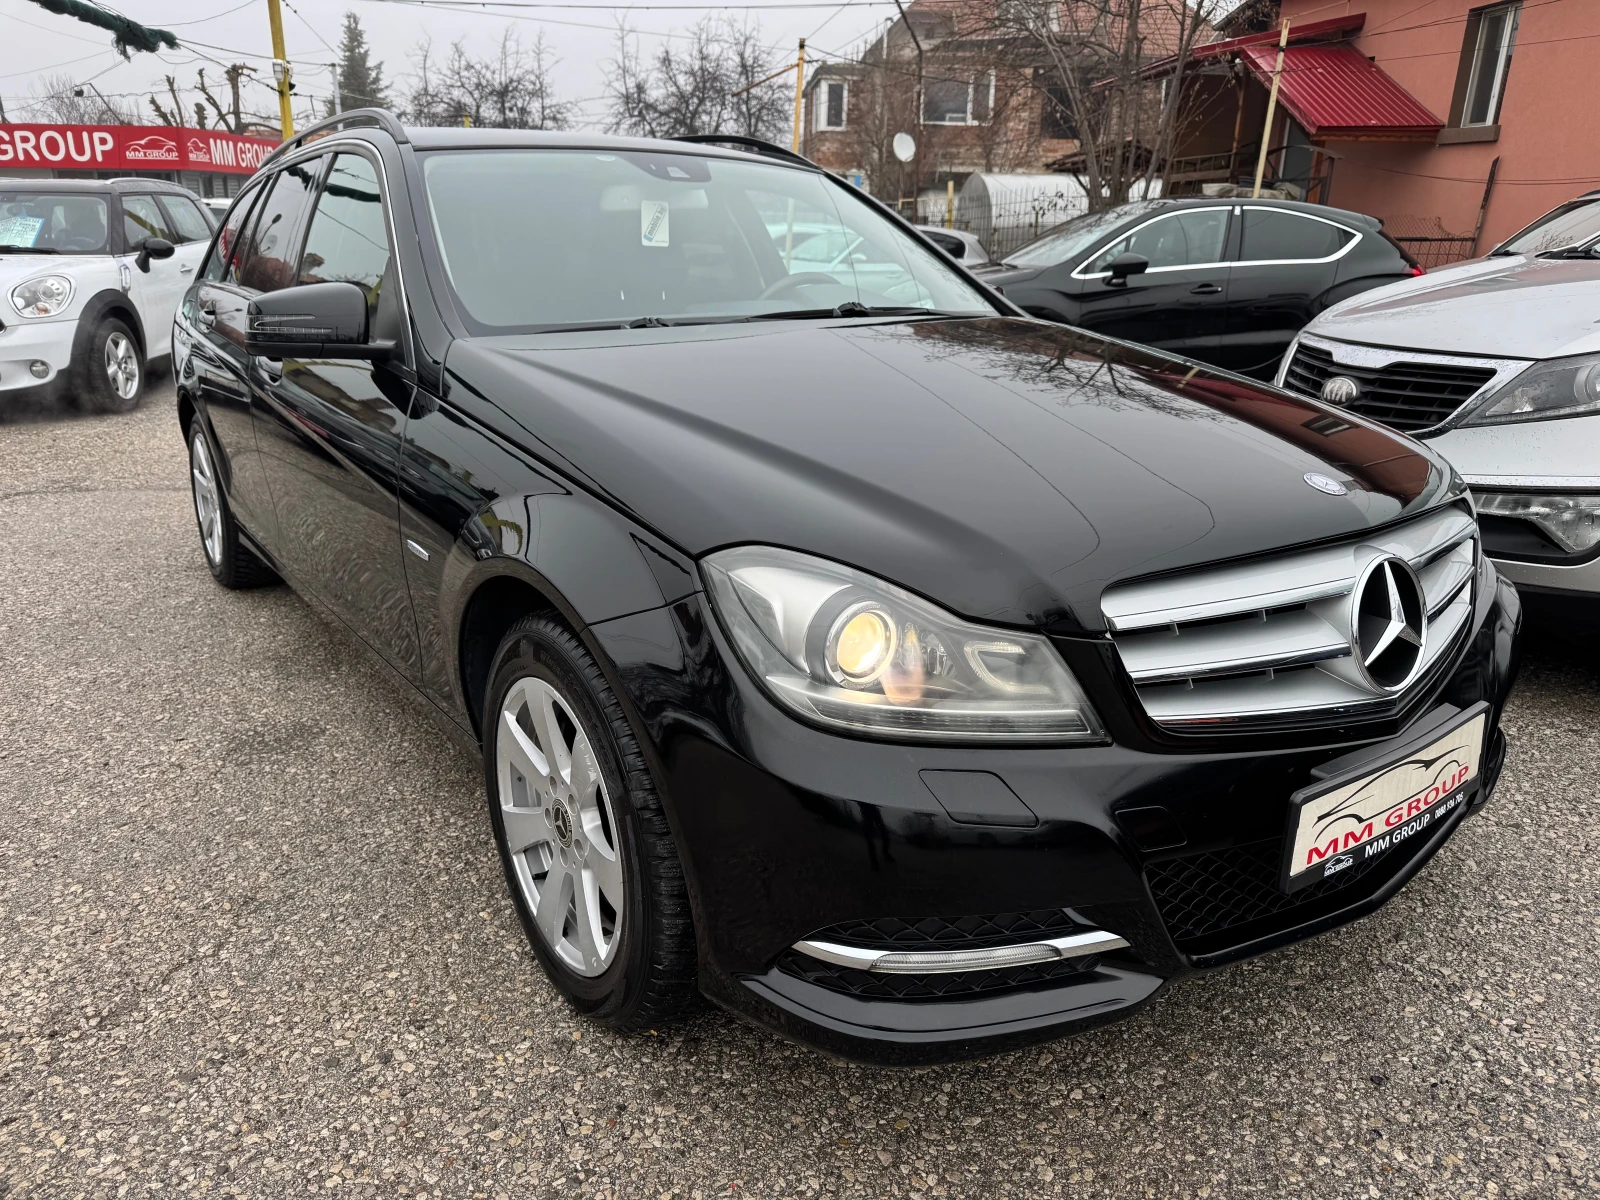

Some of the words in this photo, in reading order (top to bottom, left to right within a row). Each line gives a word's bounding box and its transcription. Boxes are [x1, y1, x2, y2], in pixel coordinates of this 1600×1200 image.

[126, 150, 144, 158] MM
[146, 151, 179, 159] GROUP
[209, 138, 236, 166] MM
[1306, 822, 1373, 865] MM
[1384, 765, 1469, 827] GROUP
[1364, 836, 1390, 858] MM
[1392, 814, 1430, 844] GROUP
